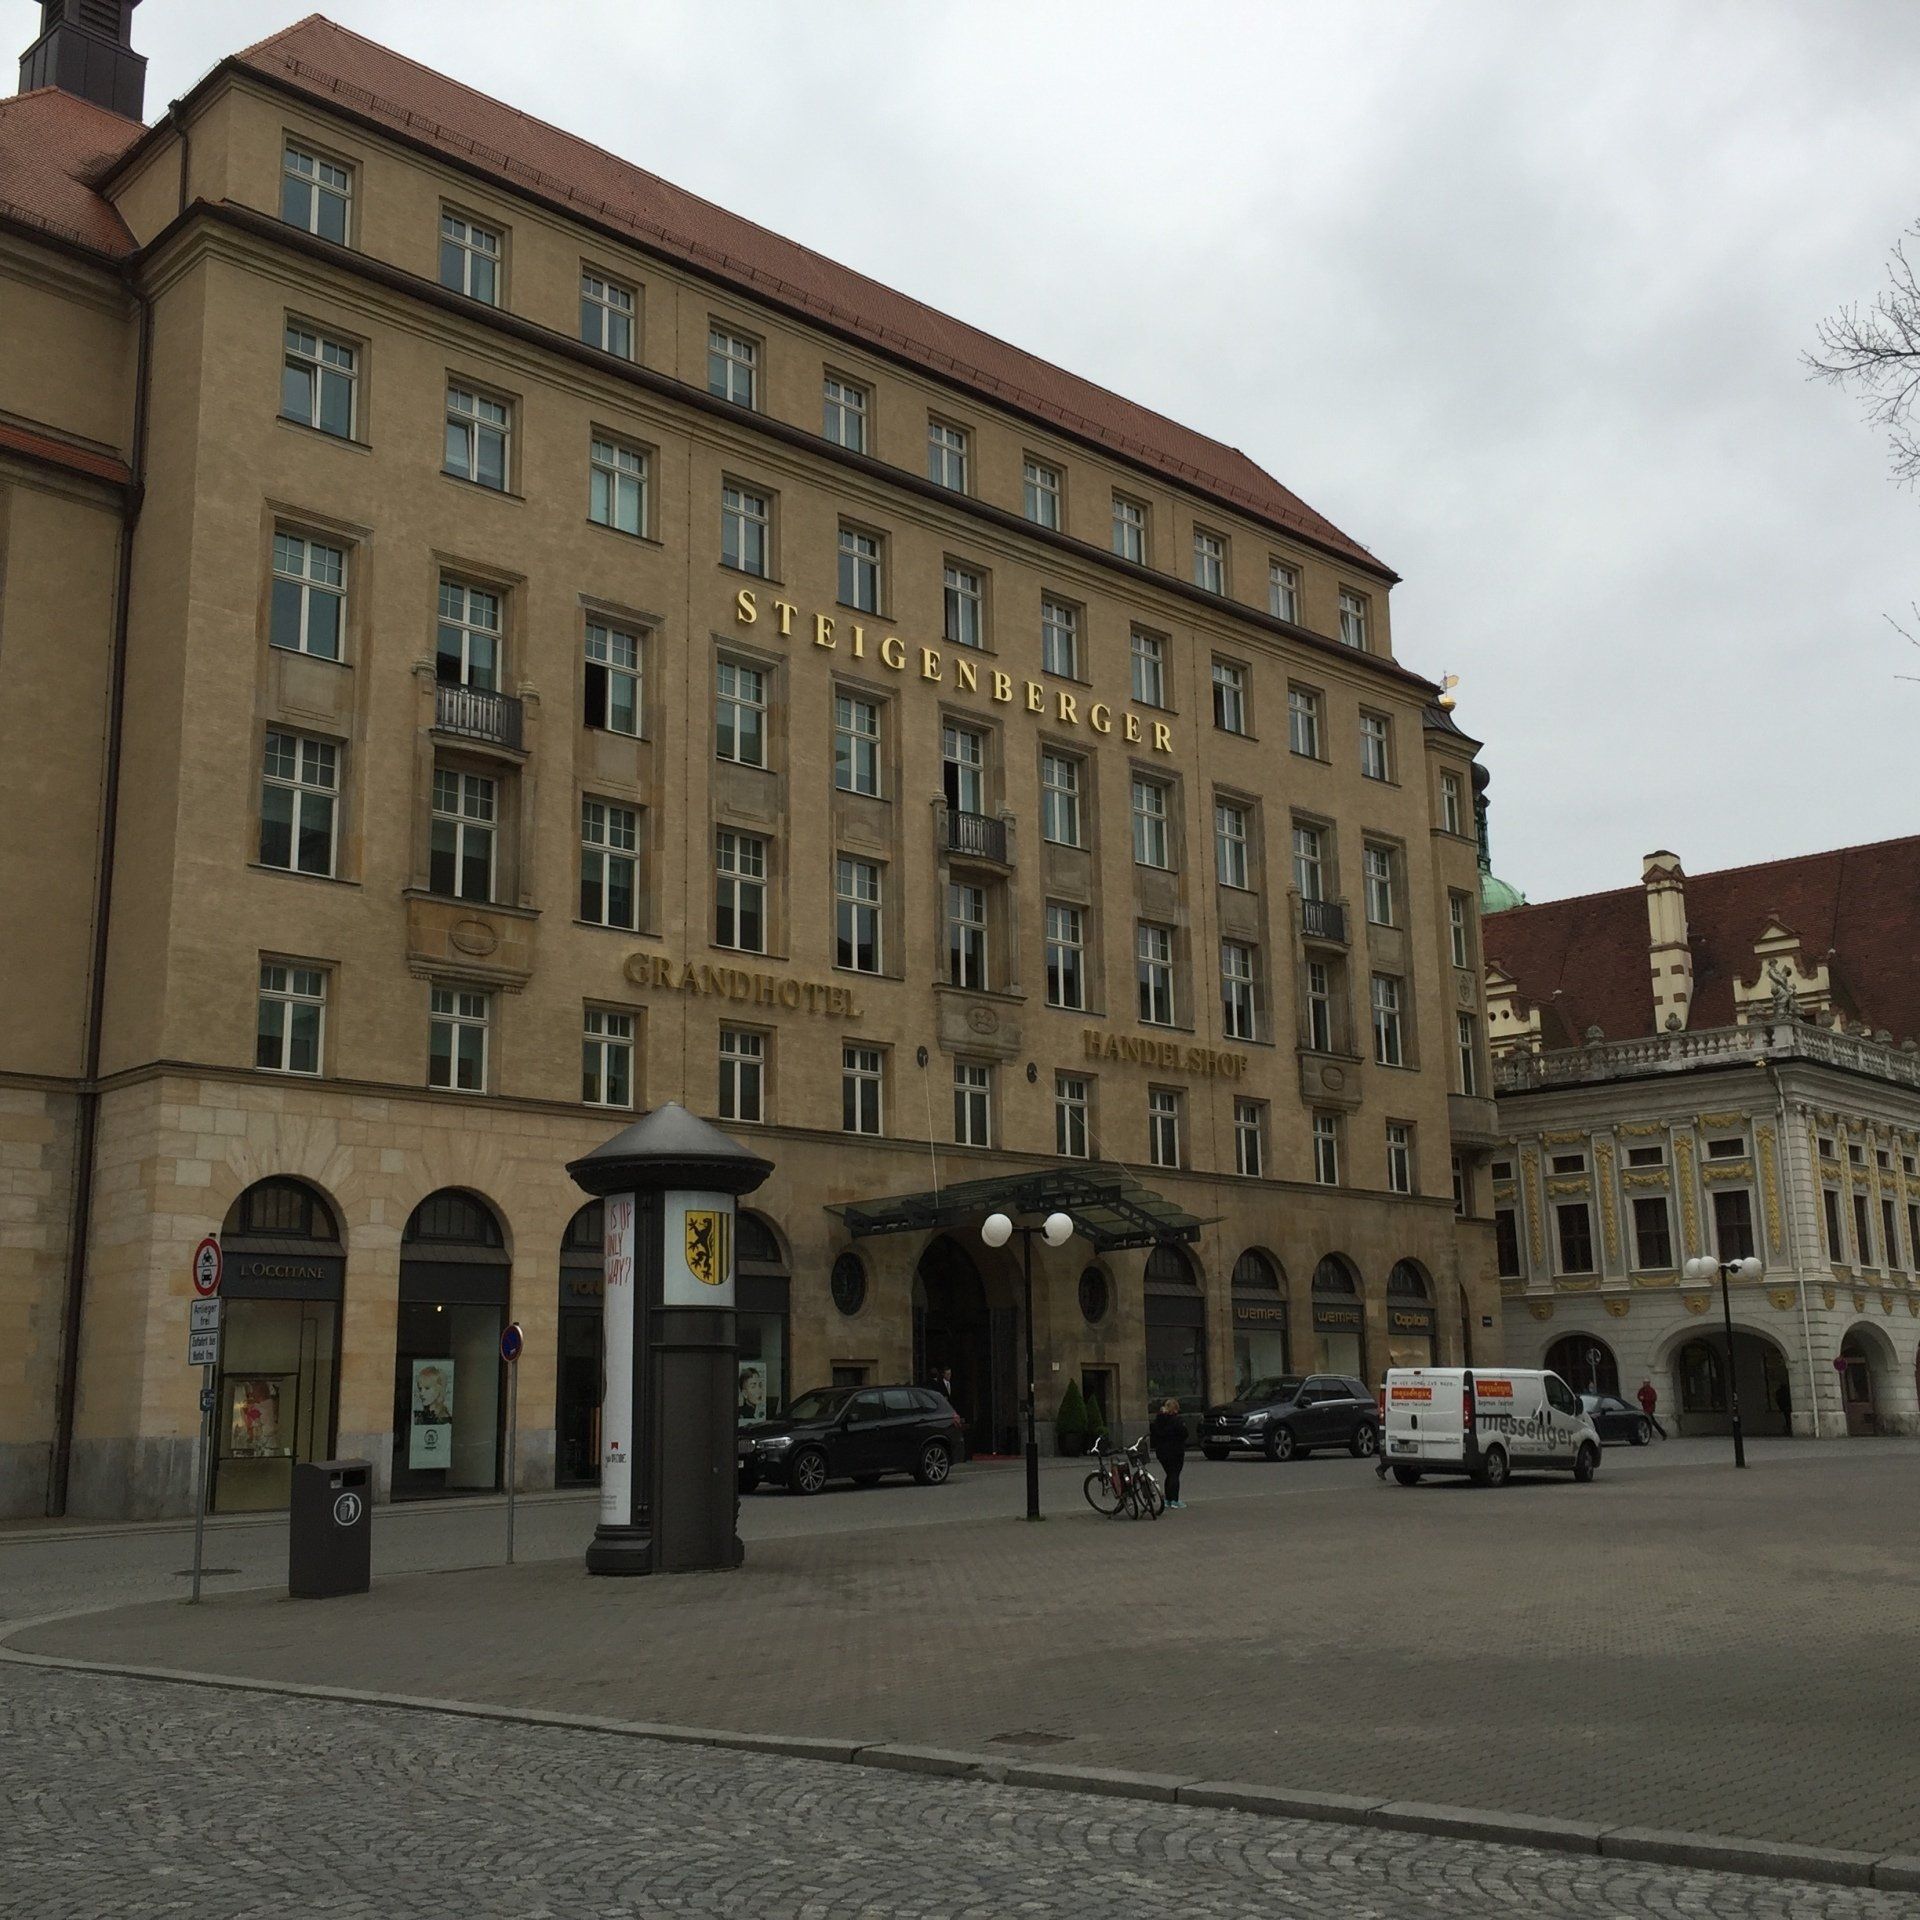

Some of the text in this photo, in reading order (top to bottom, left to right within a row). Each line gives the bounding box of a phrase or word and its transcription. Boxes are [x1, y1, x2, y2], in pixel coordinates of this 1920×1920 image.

[737, 588, 1173, 753] STEIGENBERGER
[622, 951, 865, 1018] GRANDHOTEL
[1083, 1029, 1248, 1080] HANDELSHOF
[619, 1202, 632, 1231] UP
[1482, 1416, 1574, 1450] messenger
